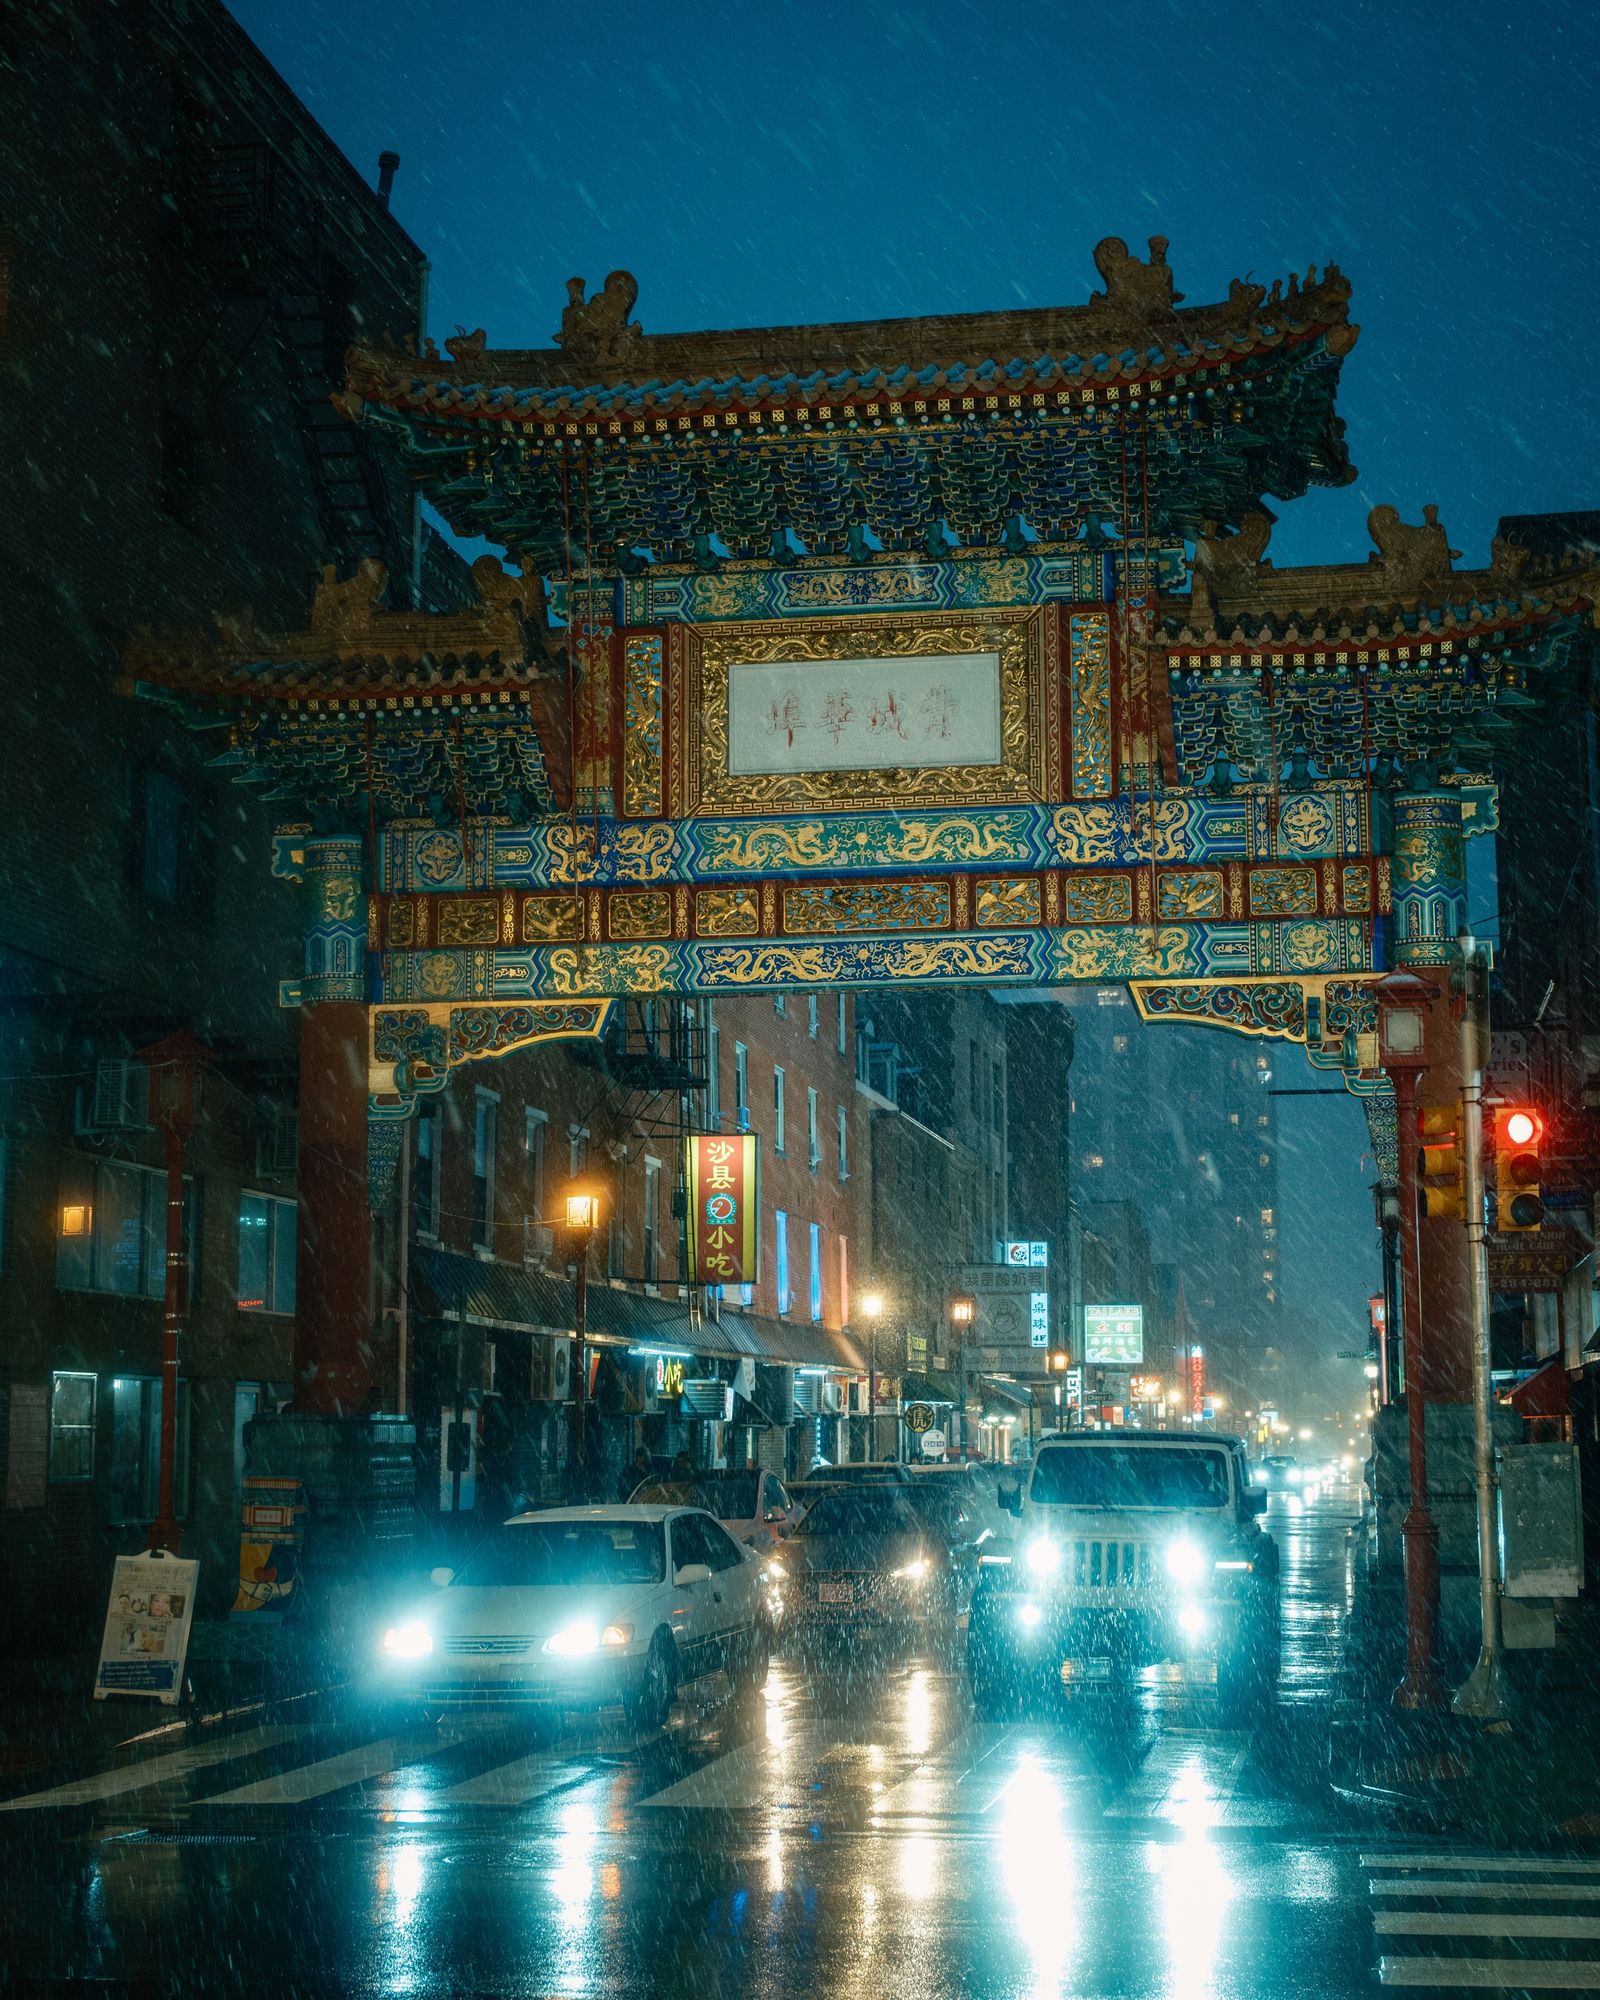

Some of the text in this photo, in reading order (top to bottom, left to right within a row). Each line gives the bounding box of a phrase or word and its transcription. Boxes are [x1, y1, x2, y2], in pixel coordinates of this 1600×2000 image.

[706, 1140, 736, 1189] 沙县
[706, 1226, 735, 1277] 小吃
[1032, 1303, 1046, 1329] 桌球
[1032, 1334, 1047, 1342] 4F
[912, 1406, 927, 1429] 虎
